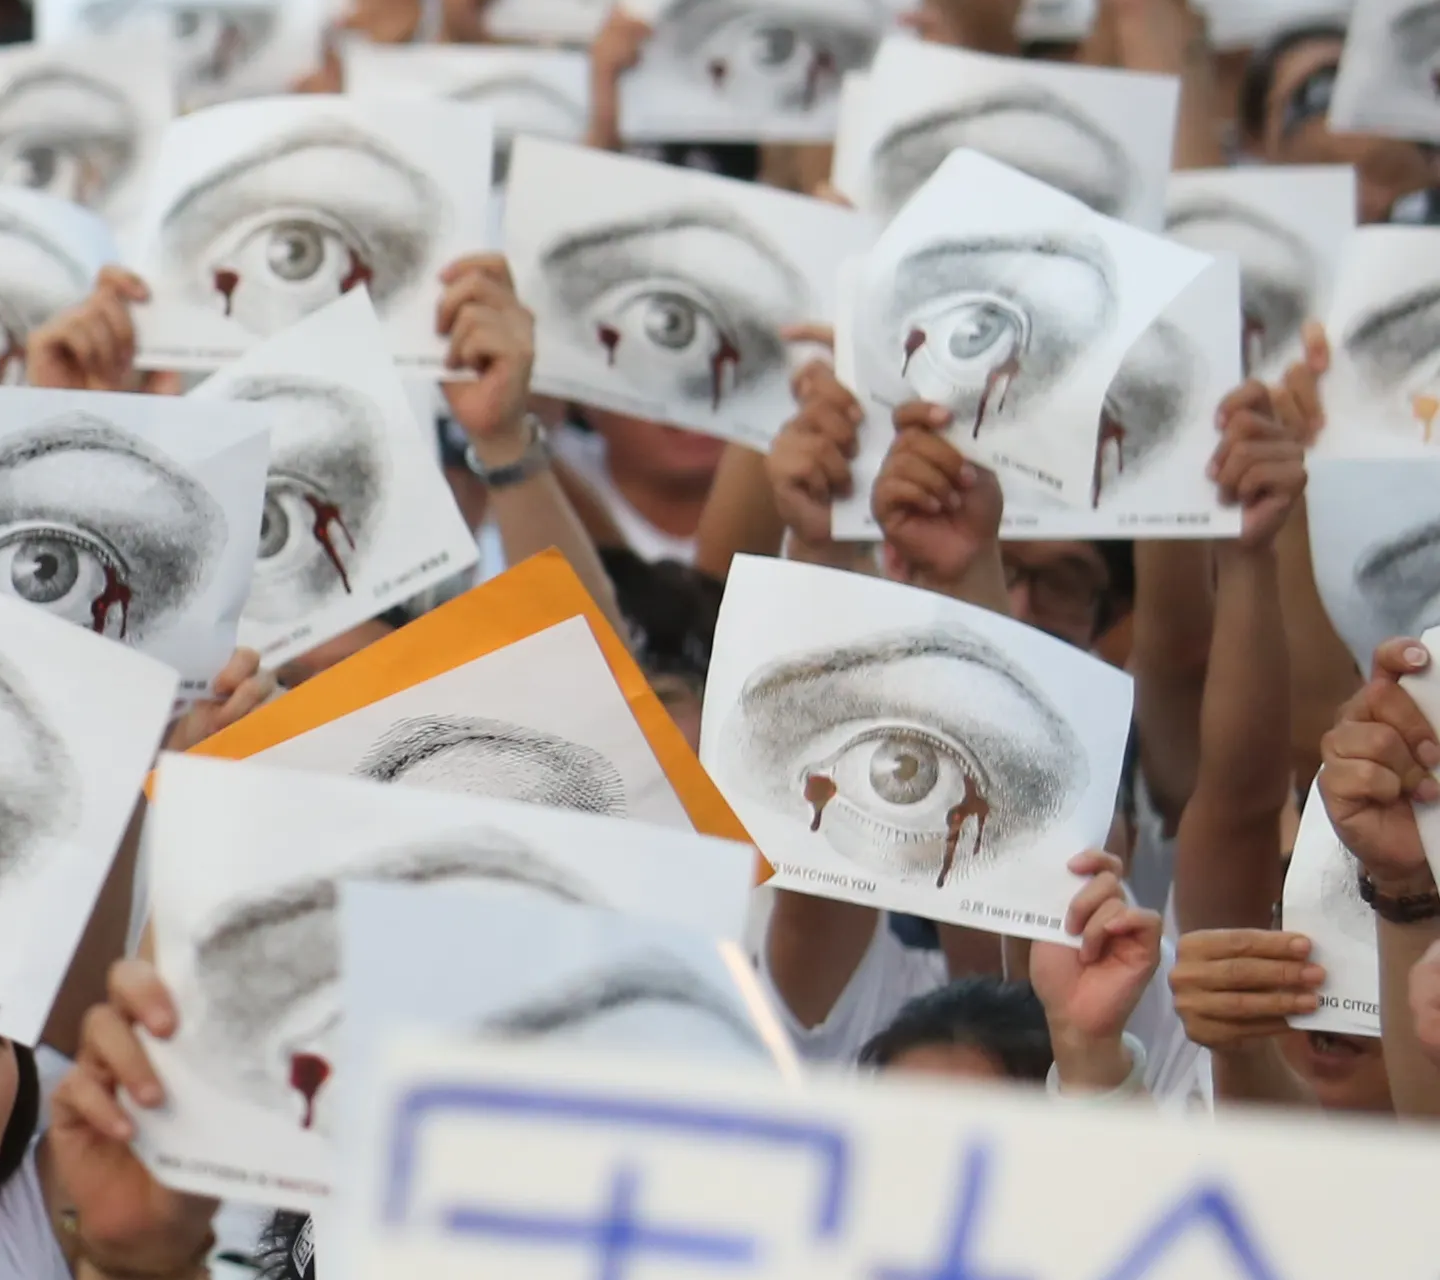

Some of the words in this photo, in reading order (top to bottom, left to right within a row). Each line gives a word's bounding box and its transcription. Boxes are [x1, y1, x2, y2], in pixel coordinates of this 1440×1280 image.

[782, 863, 848, 887] WATCHING
[851, 879, 877, 894] YOU
[1318, 995, 1339, 1008] BIG
[1342, 999, 1380, 1016] CITIZE
